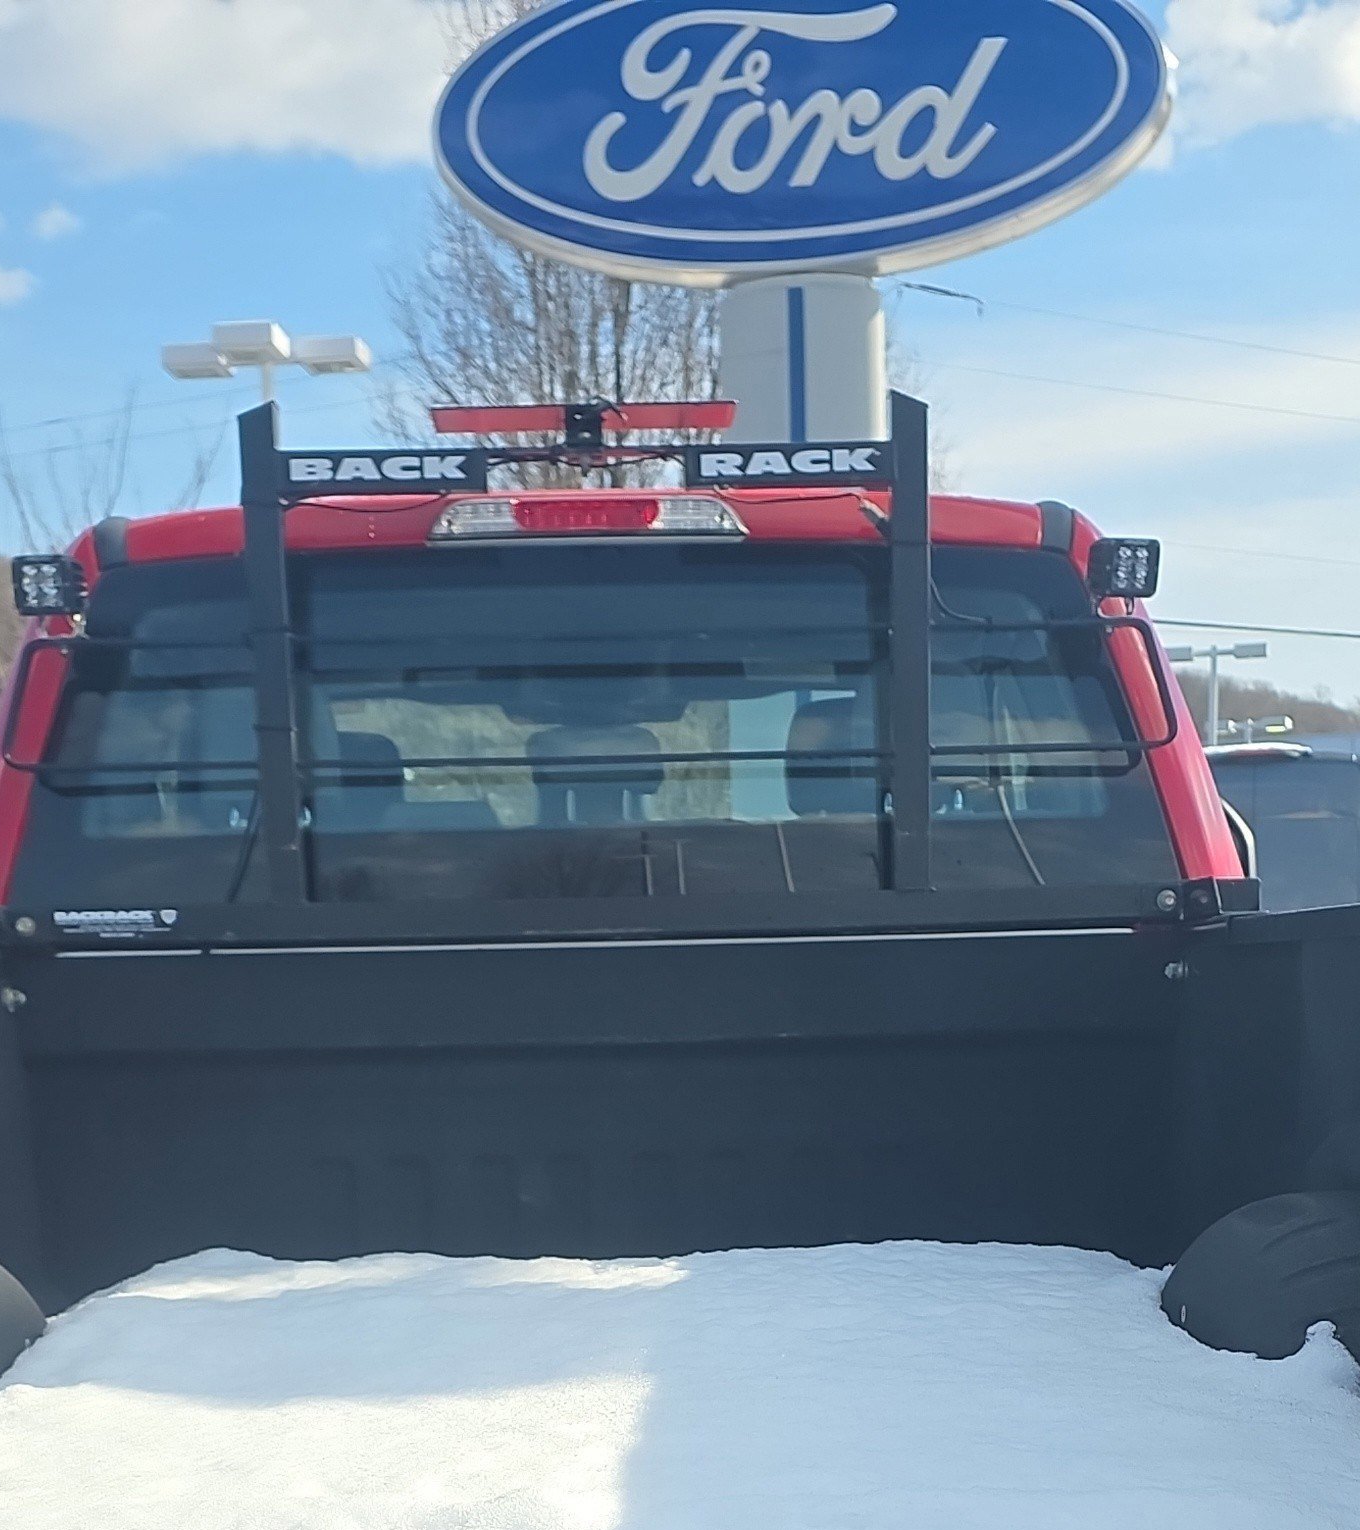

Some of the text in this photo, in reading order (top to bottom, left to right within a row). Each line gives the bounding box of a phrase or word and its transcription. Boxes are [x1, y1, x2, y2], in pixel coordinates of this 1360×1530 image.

[583, 3, 1009, 201] Ford
[289, 448, 877, 481] BACK RACK
